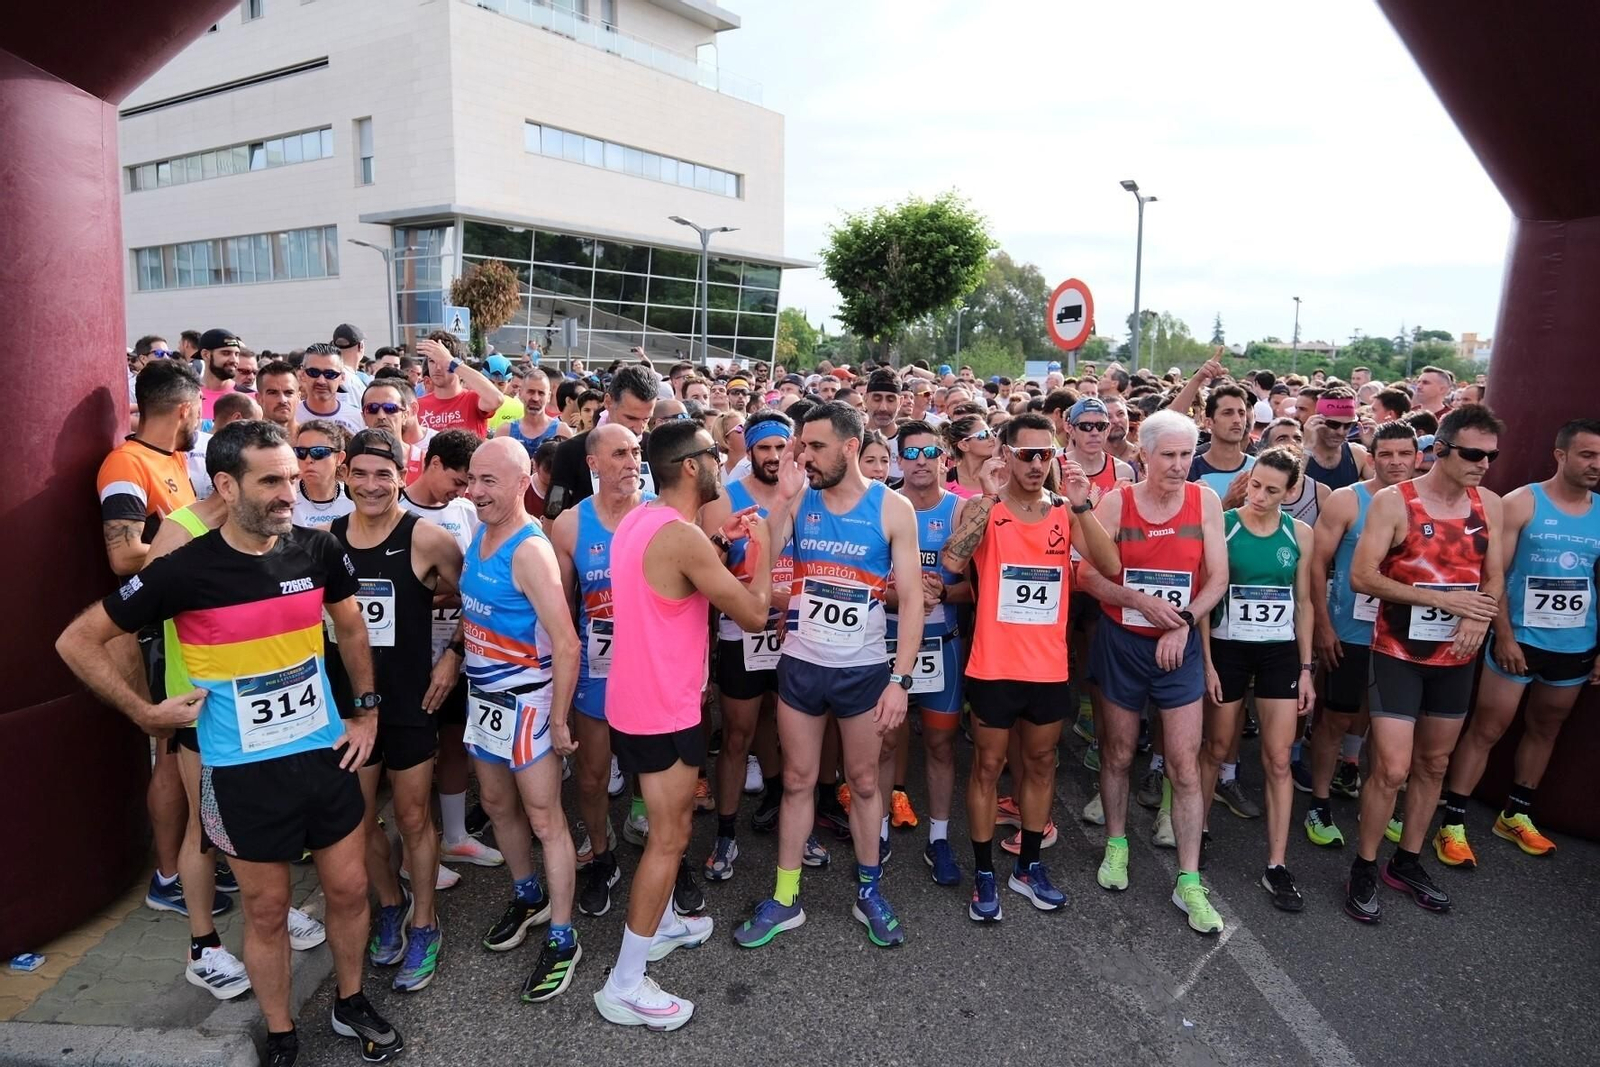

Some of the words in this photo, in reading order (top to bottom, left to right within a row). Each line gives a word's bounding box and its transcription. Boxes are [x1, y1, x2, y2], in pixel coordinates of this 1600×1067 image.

[800, 538, 869, 556] enerplus
[1529, 533, 1600, 546] KANIN
[806, 563, 857, 580] Maratón
[1016, 584, 1048, 605] 94
[1534, 593, 1583, 611] 786
[808, 599, 859, 627] 706
[1239, 603, 1286, 622] 137
[251, 683, 317, 724] 314
[478, 704, 503, 732] 78
